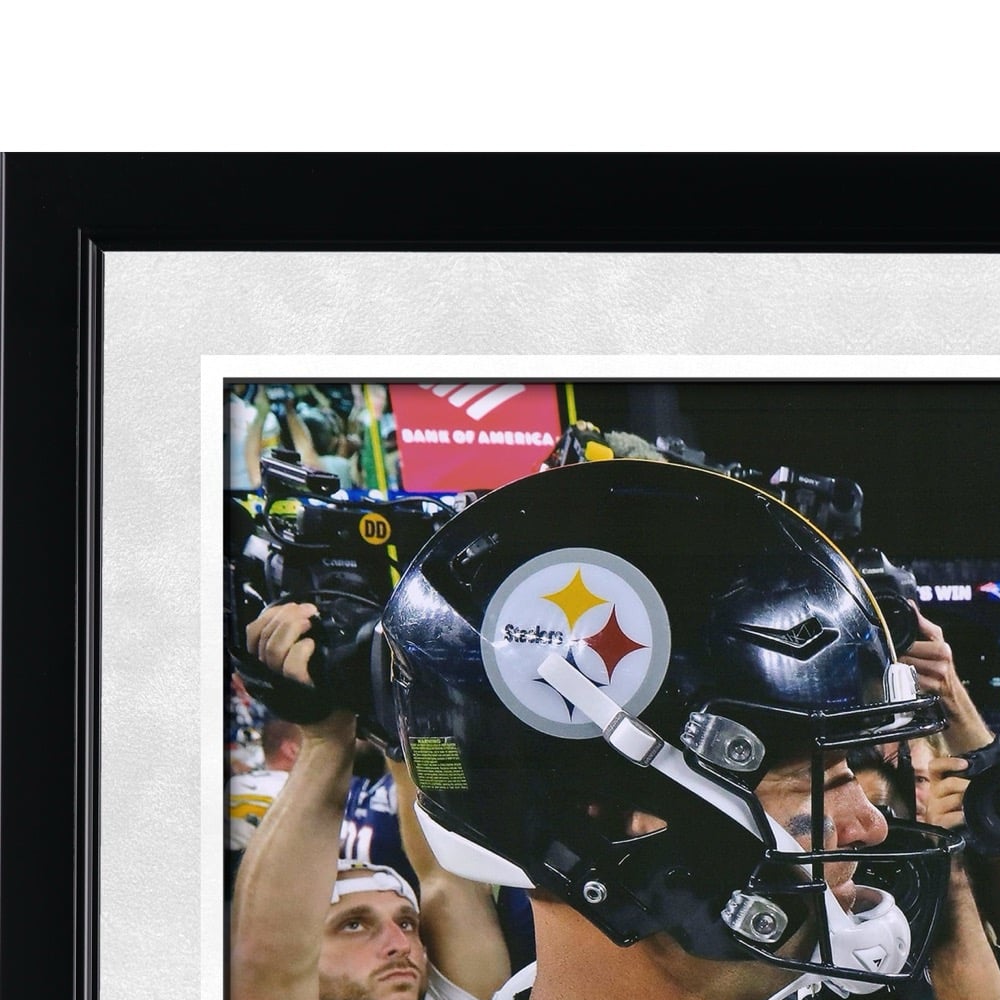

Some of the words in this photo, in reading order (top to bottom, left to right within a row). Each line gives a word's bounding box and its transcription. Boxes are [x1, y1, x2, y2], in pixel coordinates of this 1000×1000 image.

[401, 428, 449, 443] BANK
[452, 430, 475, 444] OF
[478, 430, 555, 446] AMERICA
[365, 520, 387, 538] DD
[916, 585, 933, 601] S
[935, 585, 972, 601] WIN
[504, 623, 563, 645] Steelers
